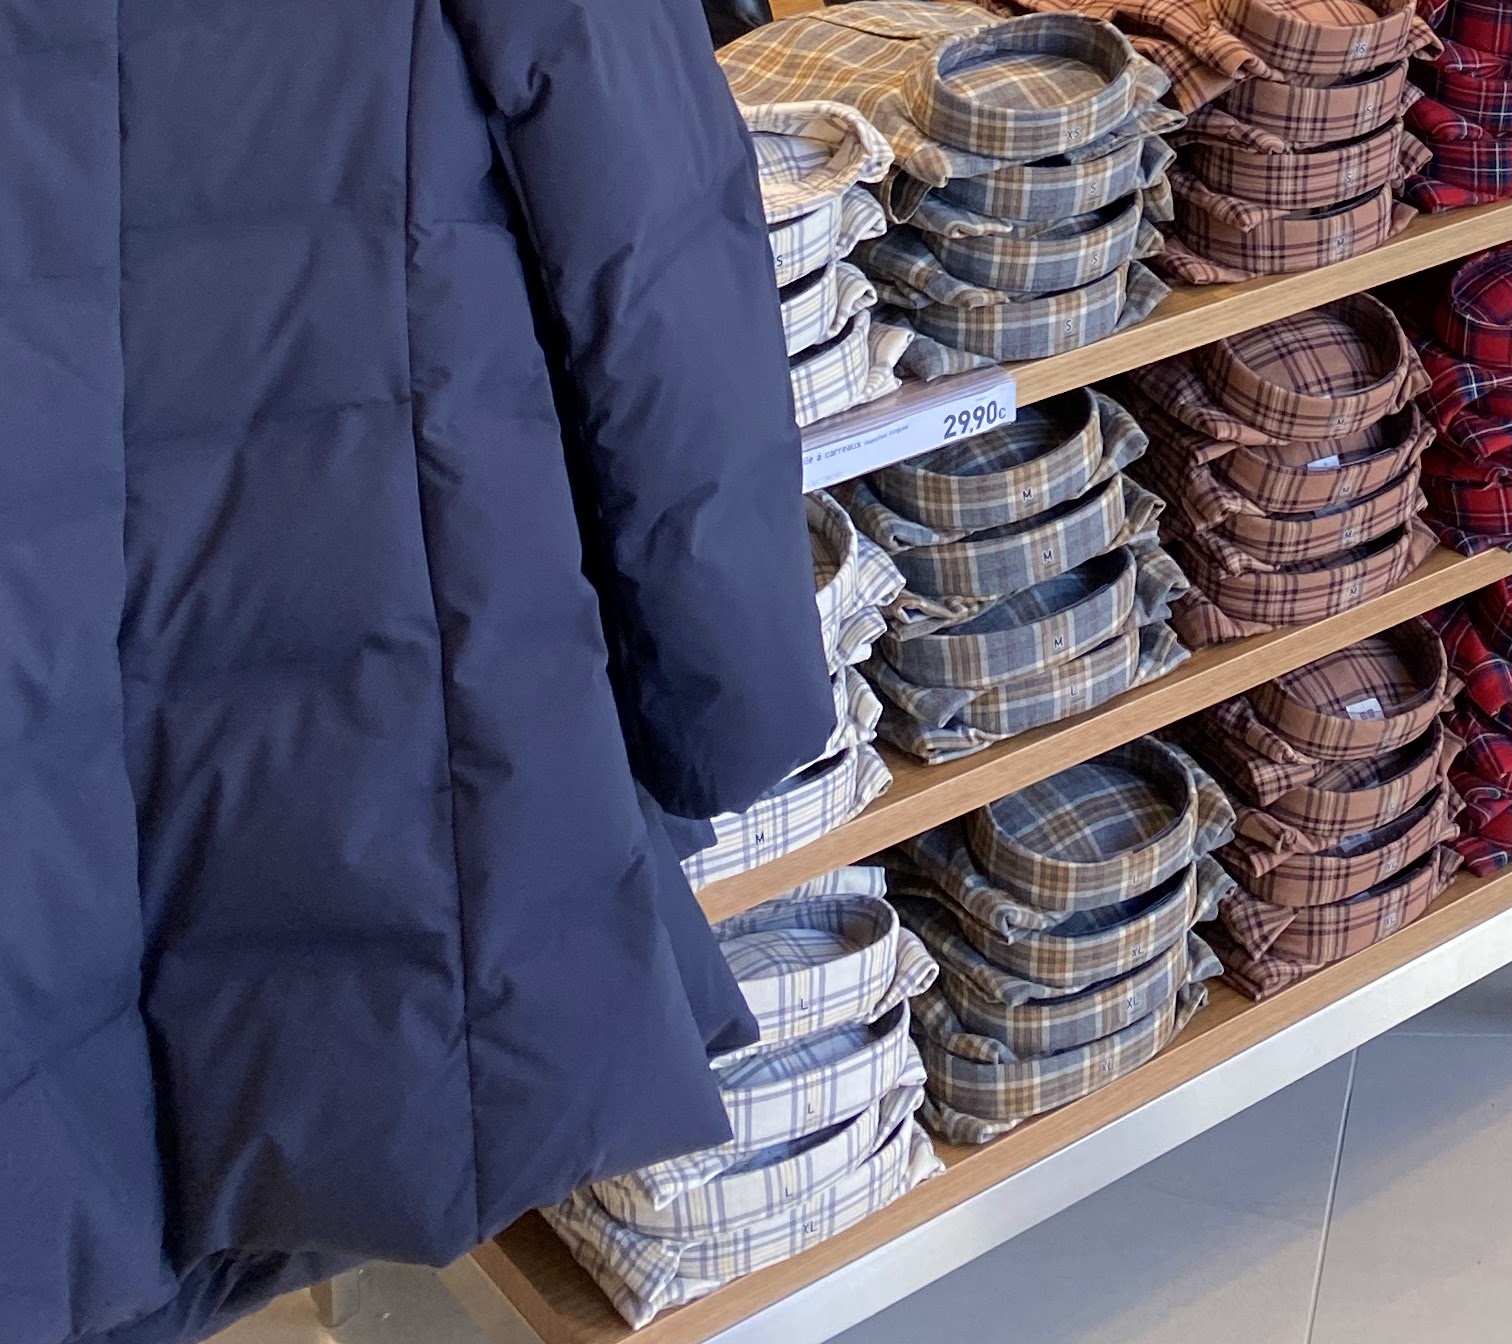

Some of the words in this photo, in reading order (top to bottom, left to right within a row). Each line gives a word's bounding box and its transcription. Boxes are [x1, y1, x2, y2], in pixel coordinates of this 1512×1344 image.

[1067, 128, 1081, 140] XS
[1090, 182, 1097, 194] S
[776, 255, 783, 267] S
[1091, 253, 1099, 266] S
[1065, 319, 1072, 332] S
[825, 442, 862, 459] carreaux
[1023, 489, 1032, 499] M
[1043, 550, 1052, 562] M
[1055, 637, 1063, 648] M
[1070, 685, 1077, 696] L
[755, 830, 765, 846] M
[1131, 945, 1144, 957] XL
[800, 998, 808, 1011] L
[1127, 997, 1141, 1009] XL
[807, 1103, 815, 1114] L
[785, 1186, 793, 1198] L
[803, 1221, 818, 1234] XL
